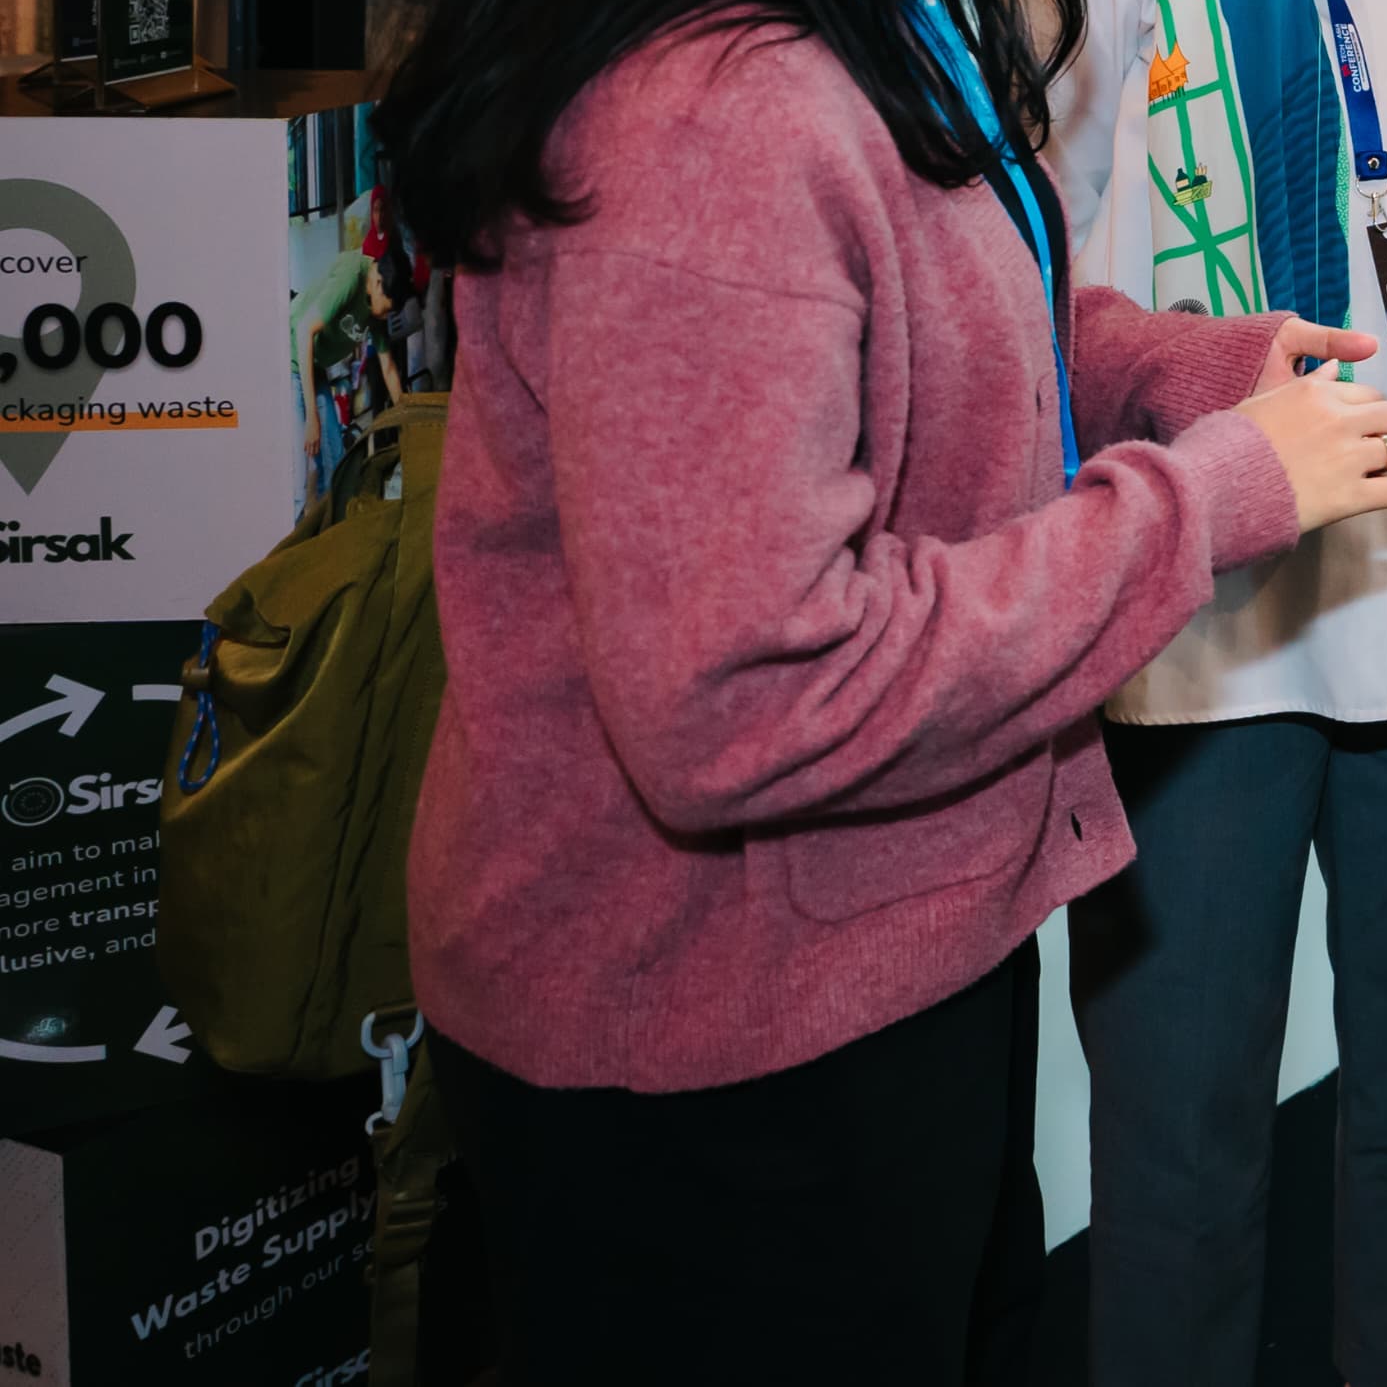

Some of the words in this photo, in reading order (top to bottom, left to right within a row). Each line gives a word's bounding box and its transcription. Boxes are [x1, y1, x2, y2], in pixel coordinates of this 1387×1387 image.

[1340, 23, 1362, 93] CONFERENCE
[0, 254, 89, 275] cover
[2, 395, 127, 427] ckaging
[138, 395, 236, 421] waste
[65, 771, 164, 816] Sirs
[11, 850, 63, 873] aim
[72, 842, 101, 863] to
[133, 866, 157, 885] in
[104, 927, 157, 955] and
[194, 1153, 361, 1263] Digitizing
[130, 1259, 252, 1342] Waste
[183, 1283, 294, 1361] through
[300, 1248, 346, 1292] our
